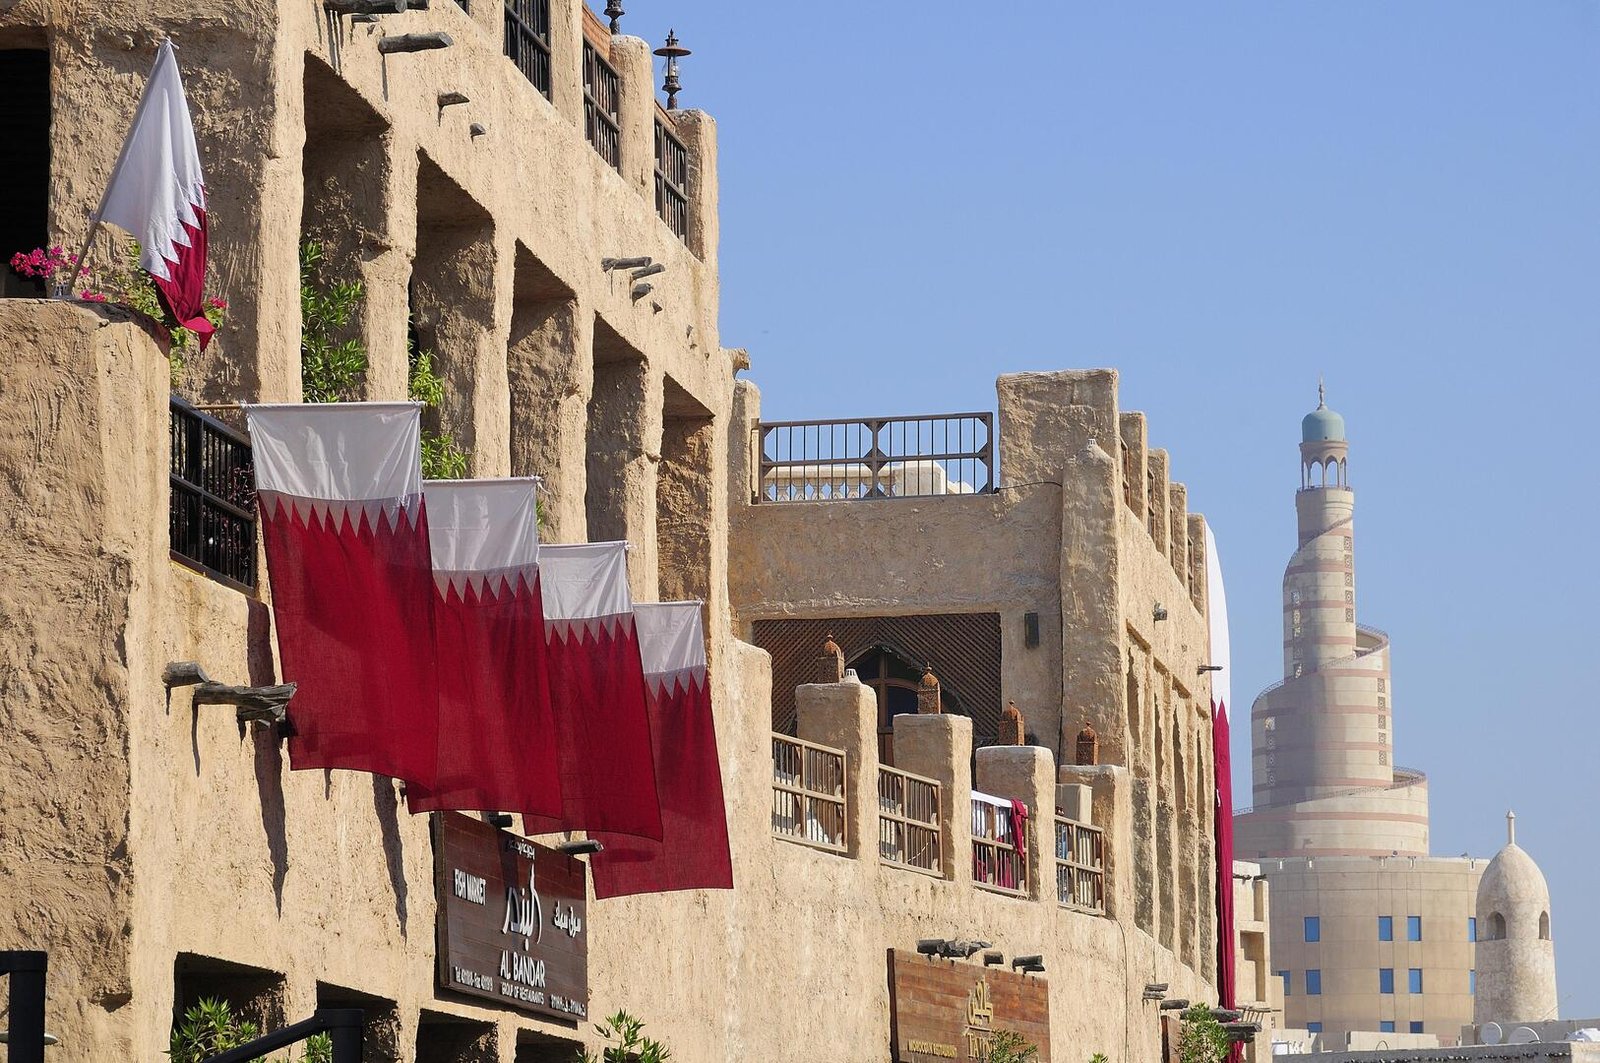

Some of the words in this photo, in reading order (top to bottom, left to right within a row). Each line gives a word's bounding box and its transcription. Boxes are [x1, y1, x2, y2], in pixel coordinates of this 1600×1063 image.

[466, 873, 486, 906] MARKET
[500, 950, 511, 980] AL
[513, 951, 546, 988] BANDAR
